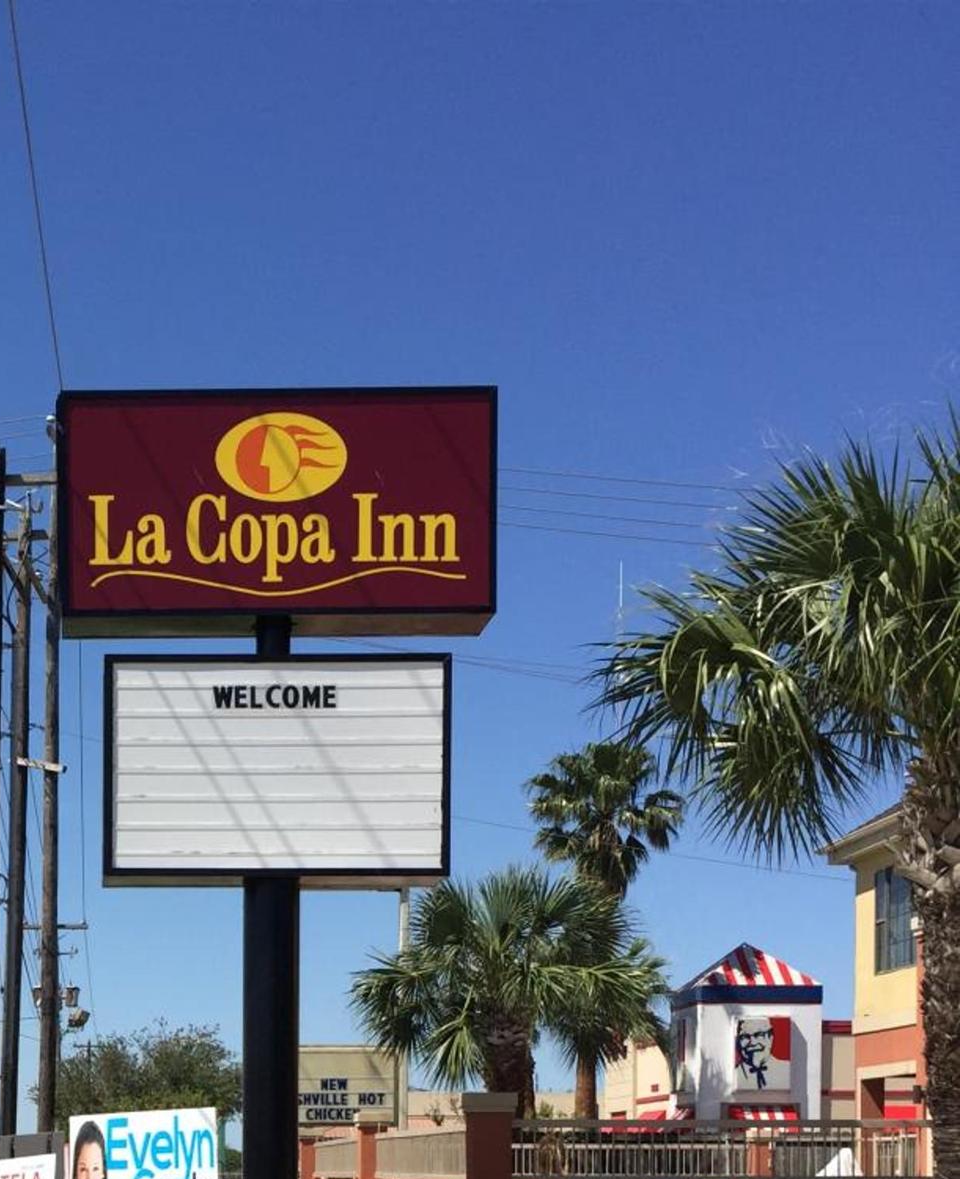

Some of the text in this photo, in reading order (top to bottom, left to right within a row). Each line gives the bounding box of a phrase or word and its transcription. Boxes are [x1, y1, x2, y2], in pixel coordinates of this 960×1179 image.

[88, 493, 461, 583] La Copa Inn
[212, 685, 337, 710] WELCOME
[320, 1078, 348, 1091] NEW
[358, 1093, 386, 1106] HOT
